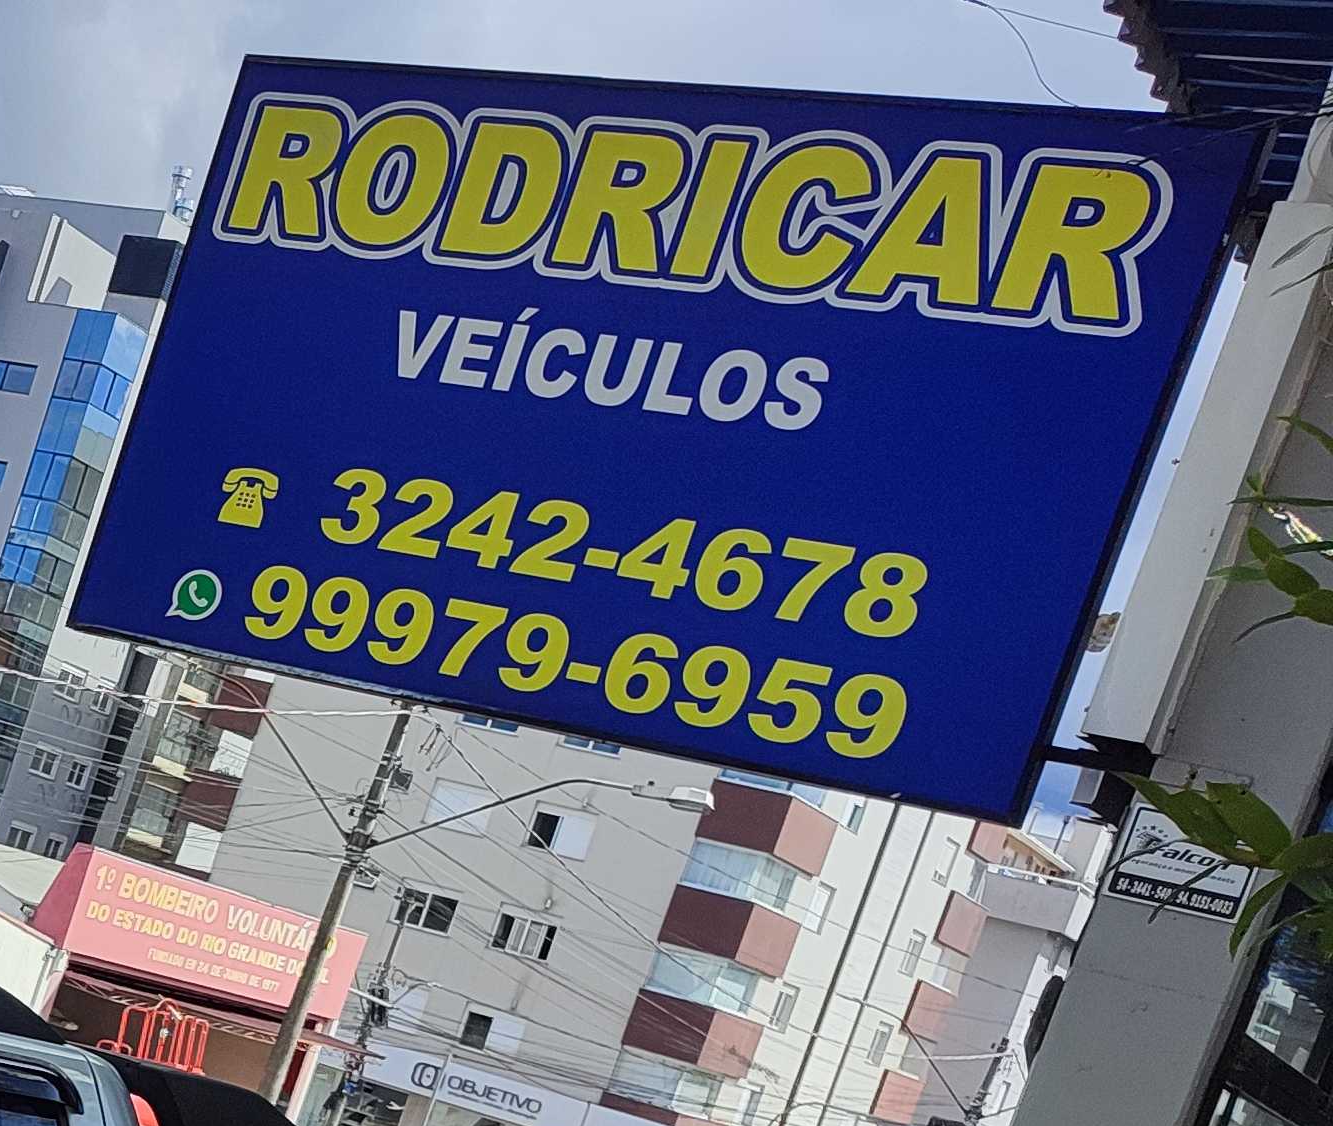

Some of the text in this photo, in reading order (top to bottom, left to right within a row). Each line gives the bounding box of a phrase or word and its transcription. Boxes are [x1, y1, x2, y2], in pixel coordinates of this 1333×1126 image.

[223, 100, 1163, 326] RODRICAR
[396, 306, 832, 431] VEÍCULOS
[321, 468, 929, 638] 3242-4678
[245, 565, 908, 758] 99979-6959
[86, 899, 110, 923] DO
[113, 910, 175, 940] ESTADO
[176, 926, 199, 947] DO
[201, 933, 226, 954] RIO
[227, 941, 286, 973] GRANDE
[118, 871, 219, 924] BOMBEIRO
[447, 1075, 543, 1114] OBJETIVO
